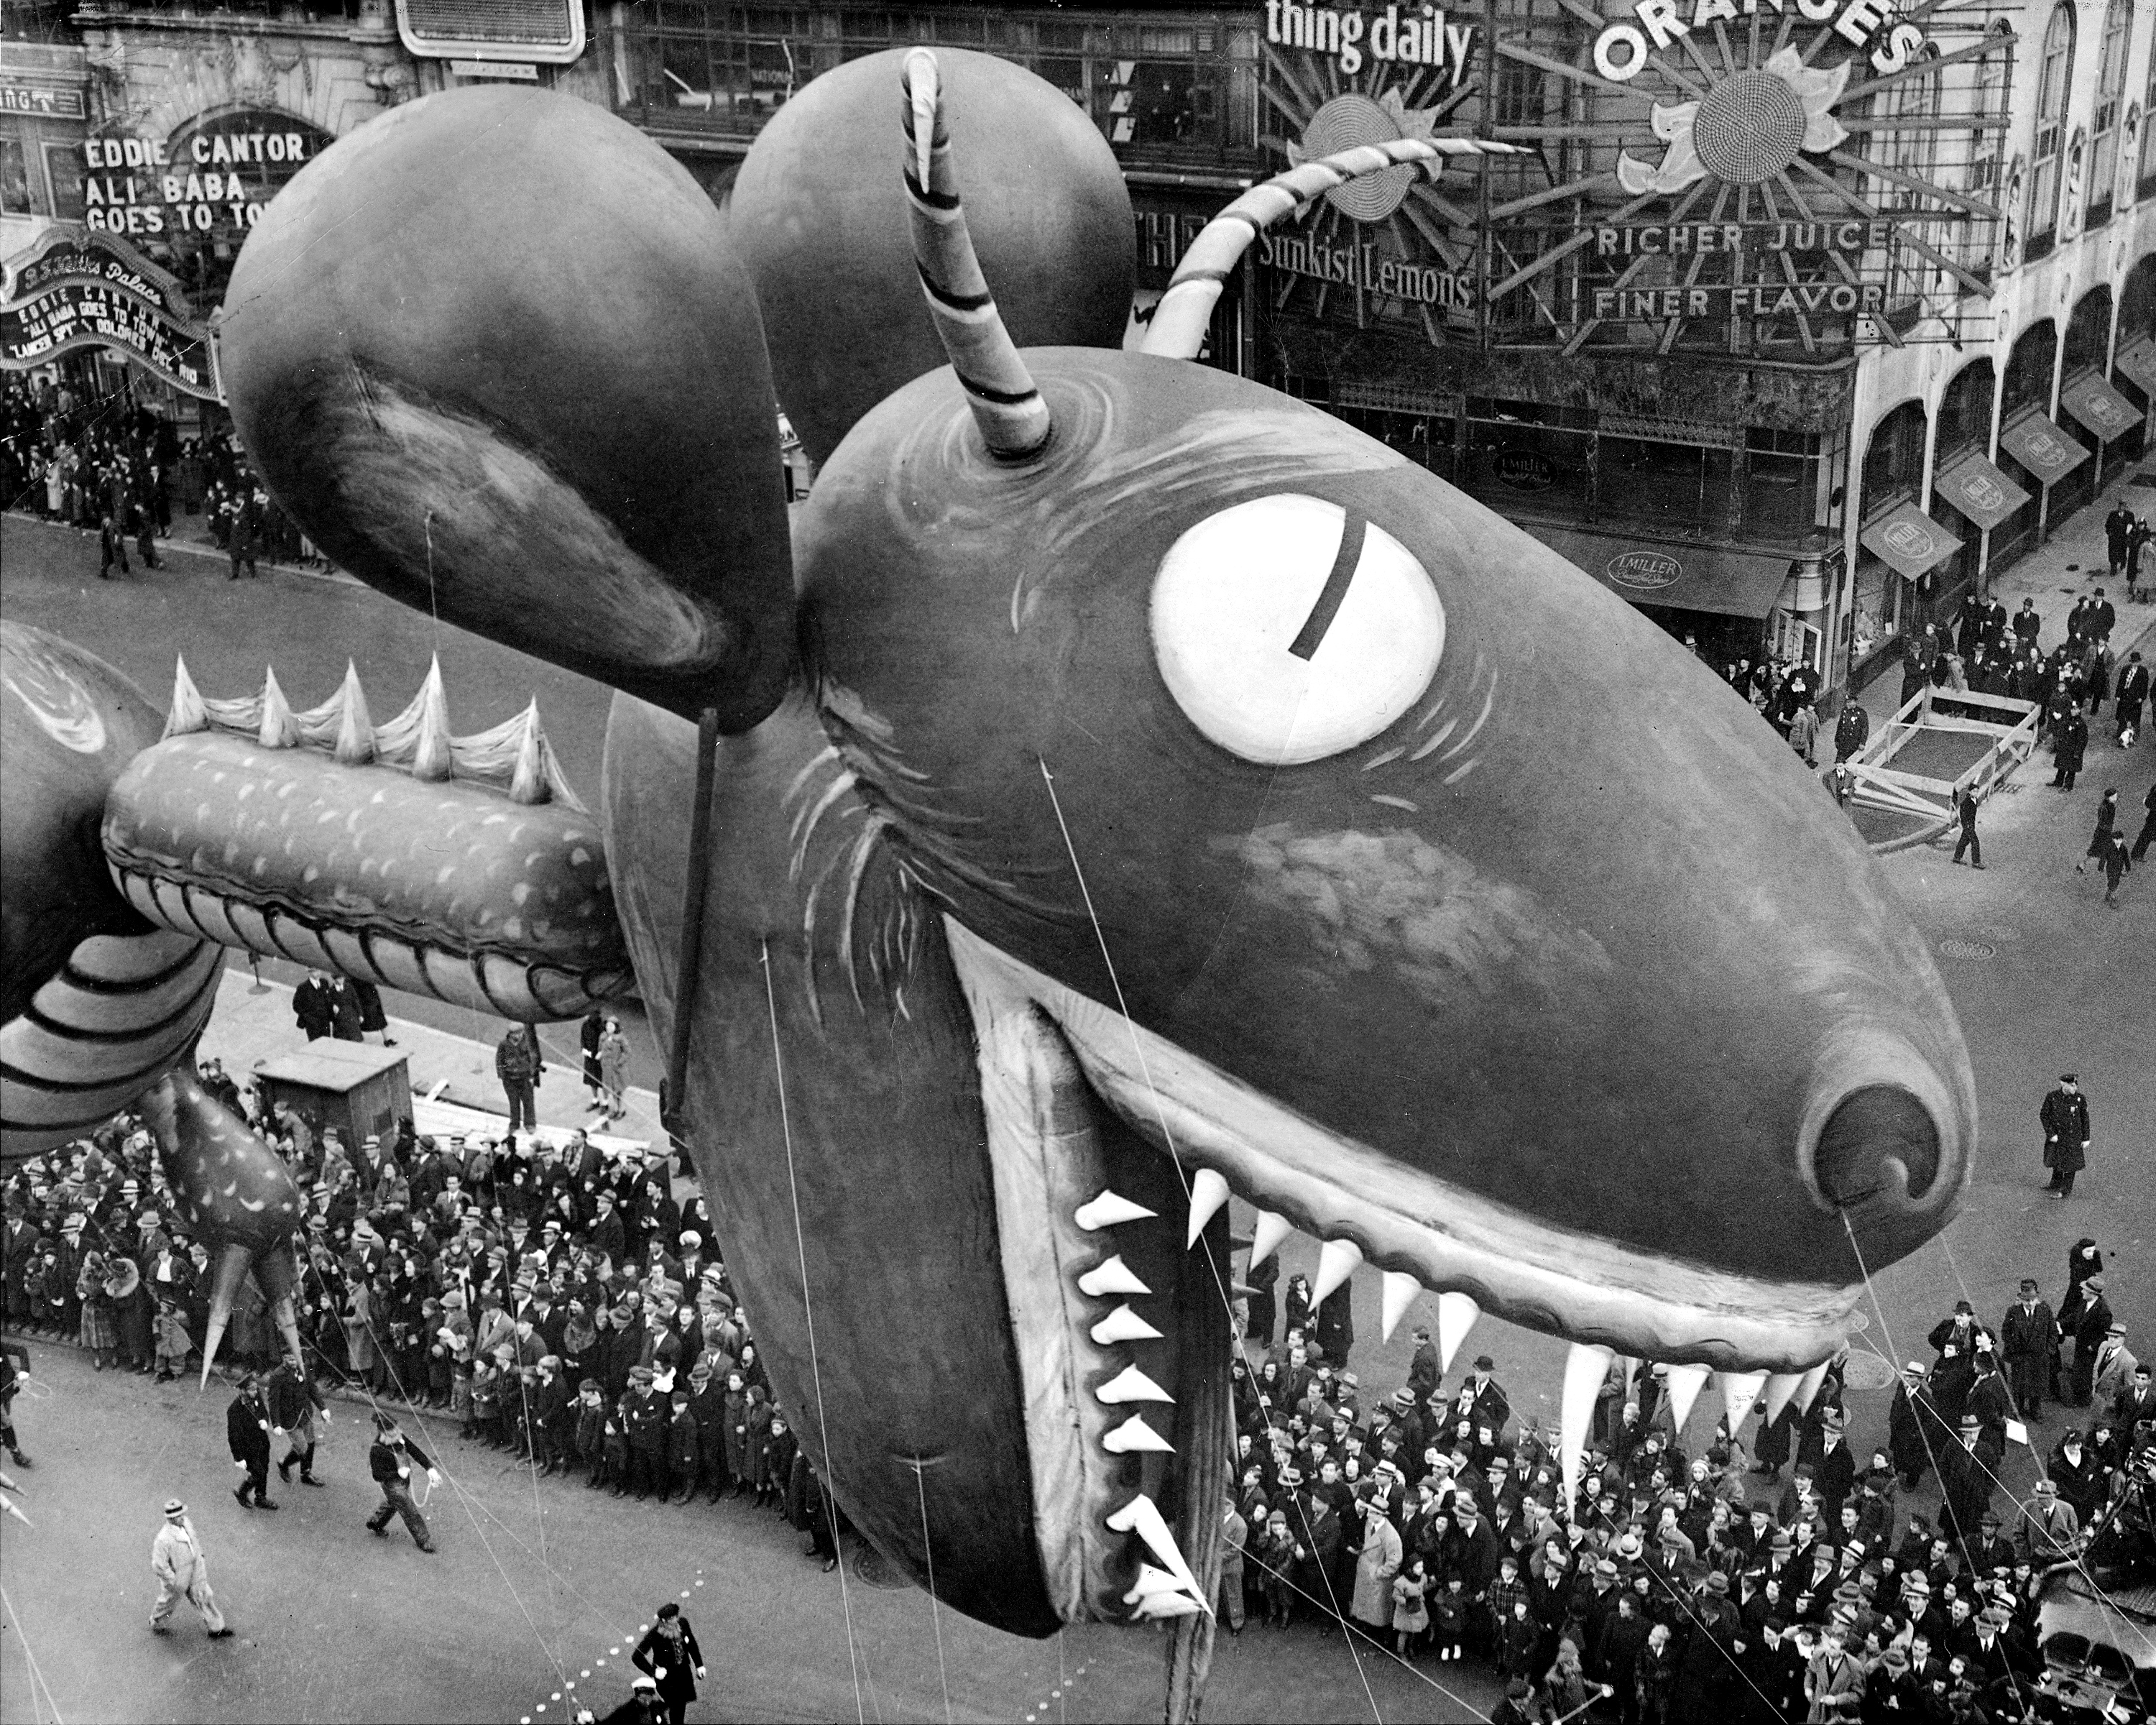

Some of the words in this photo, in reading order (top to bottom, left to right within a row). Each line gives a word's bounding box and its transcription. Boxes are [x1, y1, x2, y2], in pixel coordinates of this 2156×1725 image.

[1370, 5, 1473, 87] daily
[85, 137, 170, 167] EDDIE
[191, 132, 304, 163] CANTOR
[86, 177, 136, 206] ALI
[162, 172, 245, 203] BABA
[87, 206, 163, 234] GOES
[176, 203, 213, 231] TO
[229, 202, 271, 229] TO
[1598, 224, 1743, 255] RICHER
[1767, 221, 1887, 250] JUICE
[105, 262, 162, 305] Palace
[1258, 229, 1355, 286] Sunkist
[1363, 243, 1470, 308] Lemons
[79, 301, 107, 318] GOES
[113, 306, 127, 324] TO
[1595, 289, 1708, 318] FINER
[1731, 286, 1883, 316] FLAVOR
